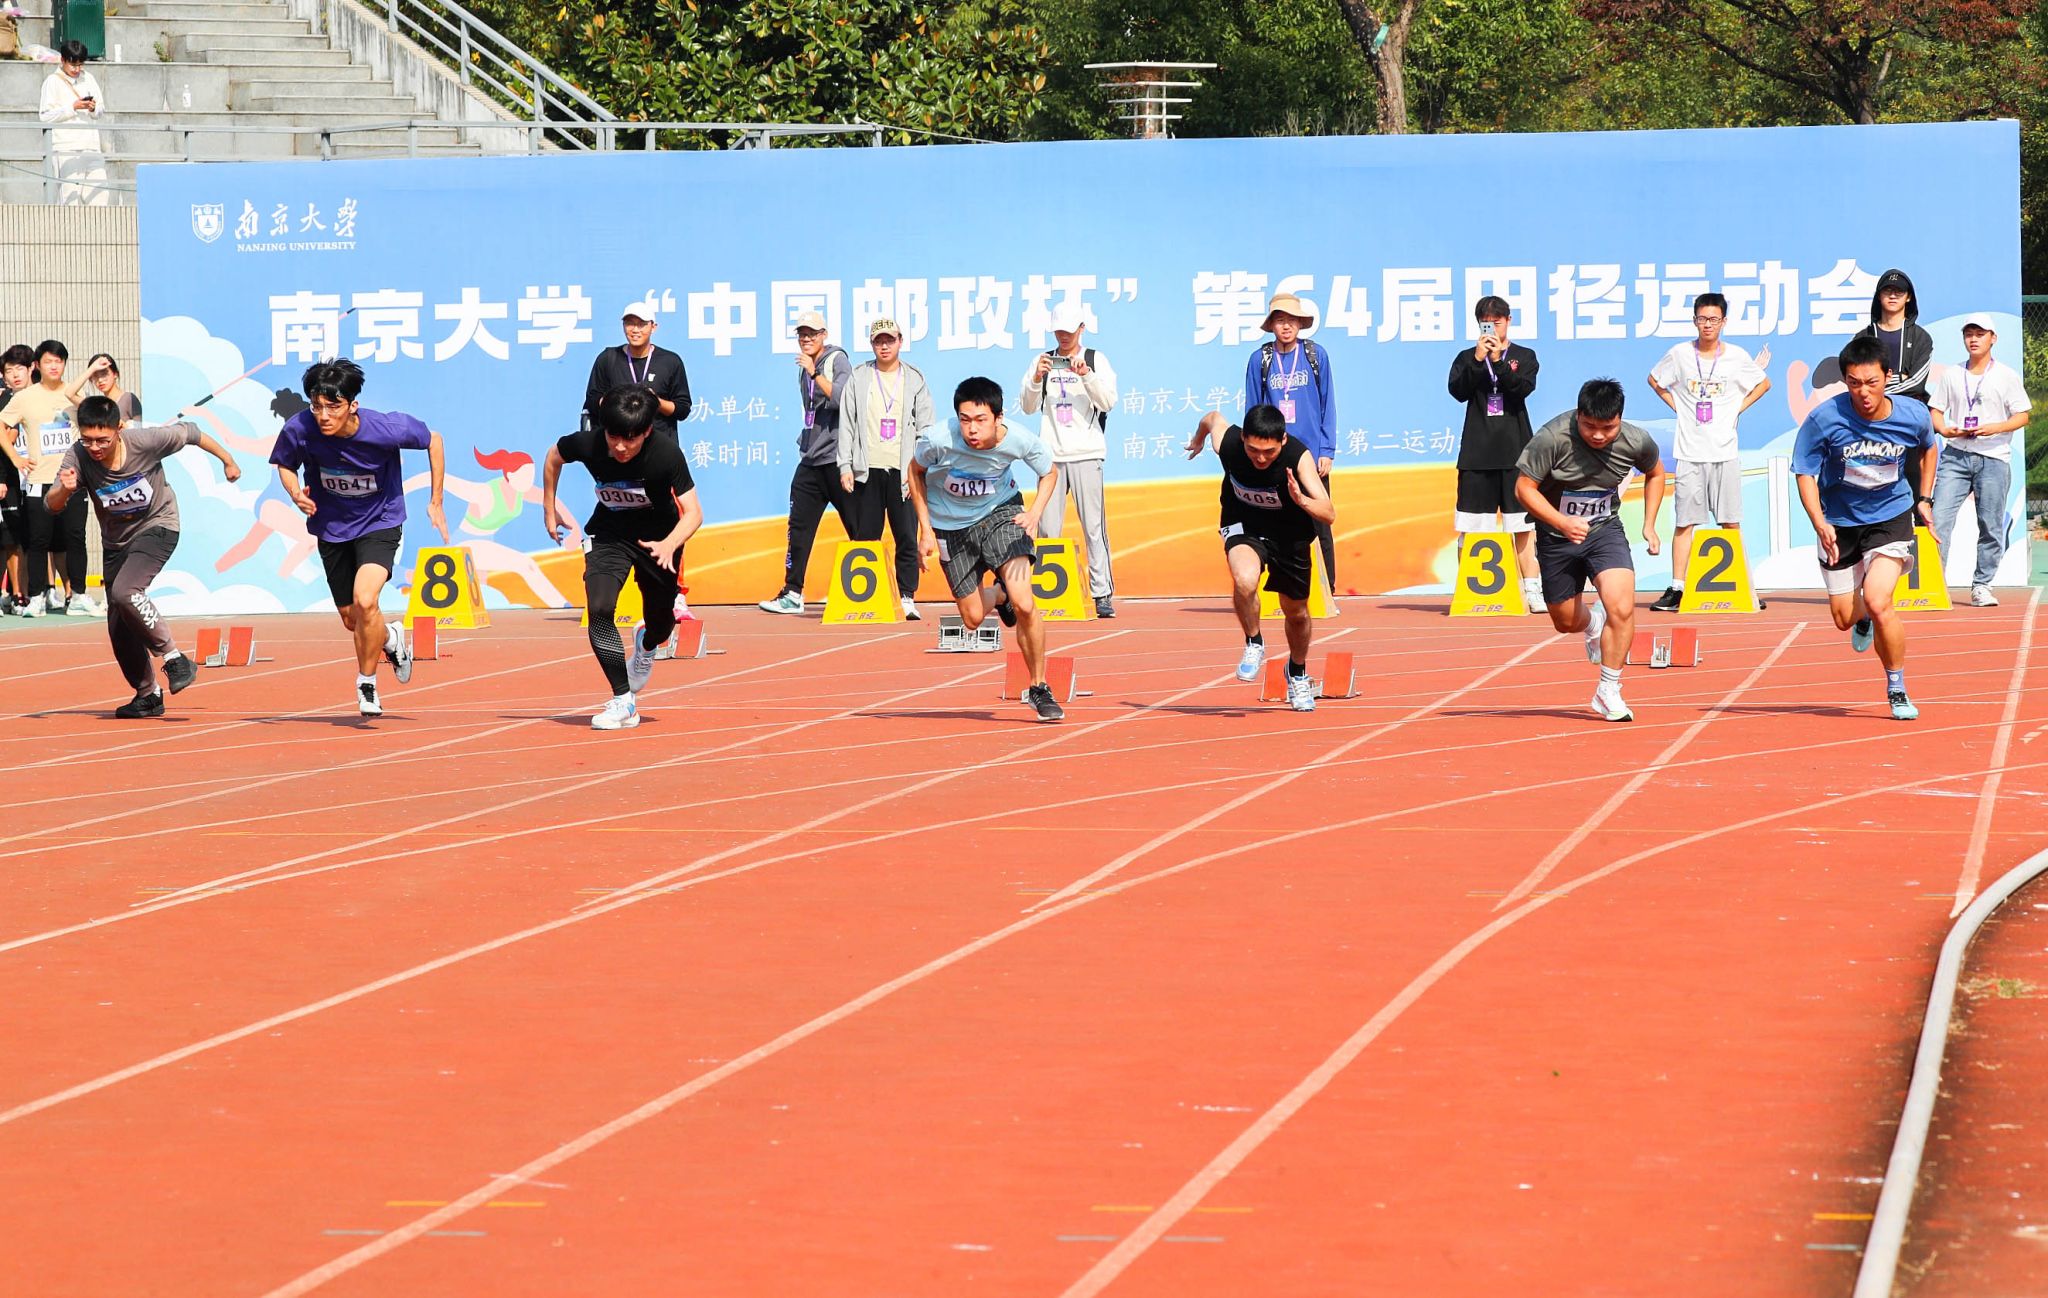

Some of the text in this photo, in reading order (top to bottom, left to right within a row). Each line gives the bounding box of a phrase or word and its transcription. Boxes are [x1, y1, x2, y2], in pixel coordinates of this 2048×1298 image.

[237, 241, 356, 252] NANJING UNIVERSITY
[268, 285, 593, 366] 南京大学
[690, 395, 781, 423] 办单位：
[43, 432, 71, 447] 0738
[682, 440, 781, 468] 赛时间：
[1335, 426, 1462, 458] 第二运动
[1843, 440, 1906, 458] DIAMOND
[326, 478, 370, 491] 0647
[421, 554, 459, 609] 8
[840, 548, 878, 603] 6
[1031, 544, 1069, 600] 5
[1466, 539, 1506, 595] 3
[1695, 537, 1737, 592] 2
